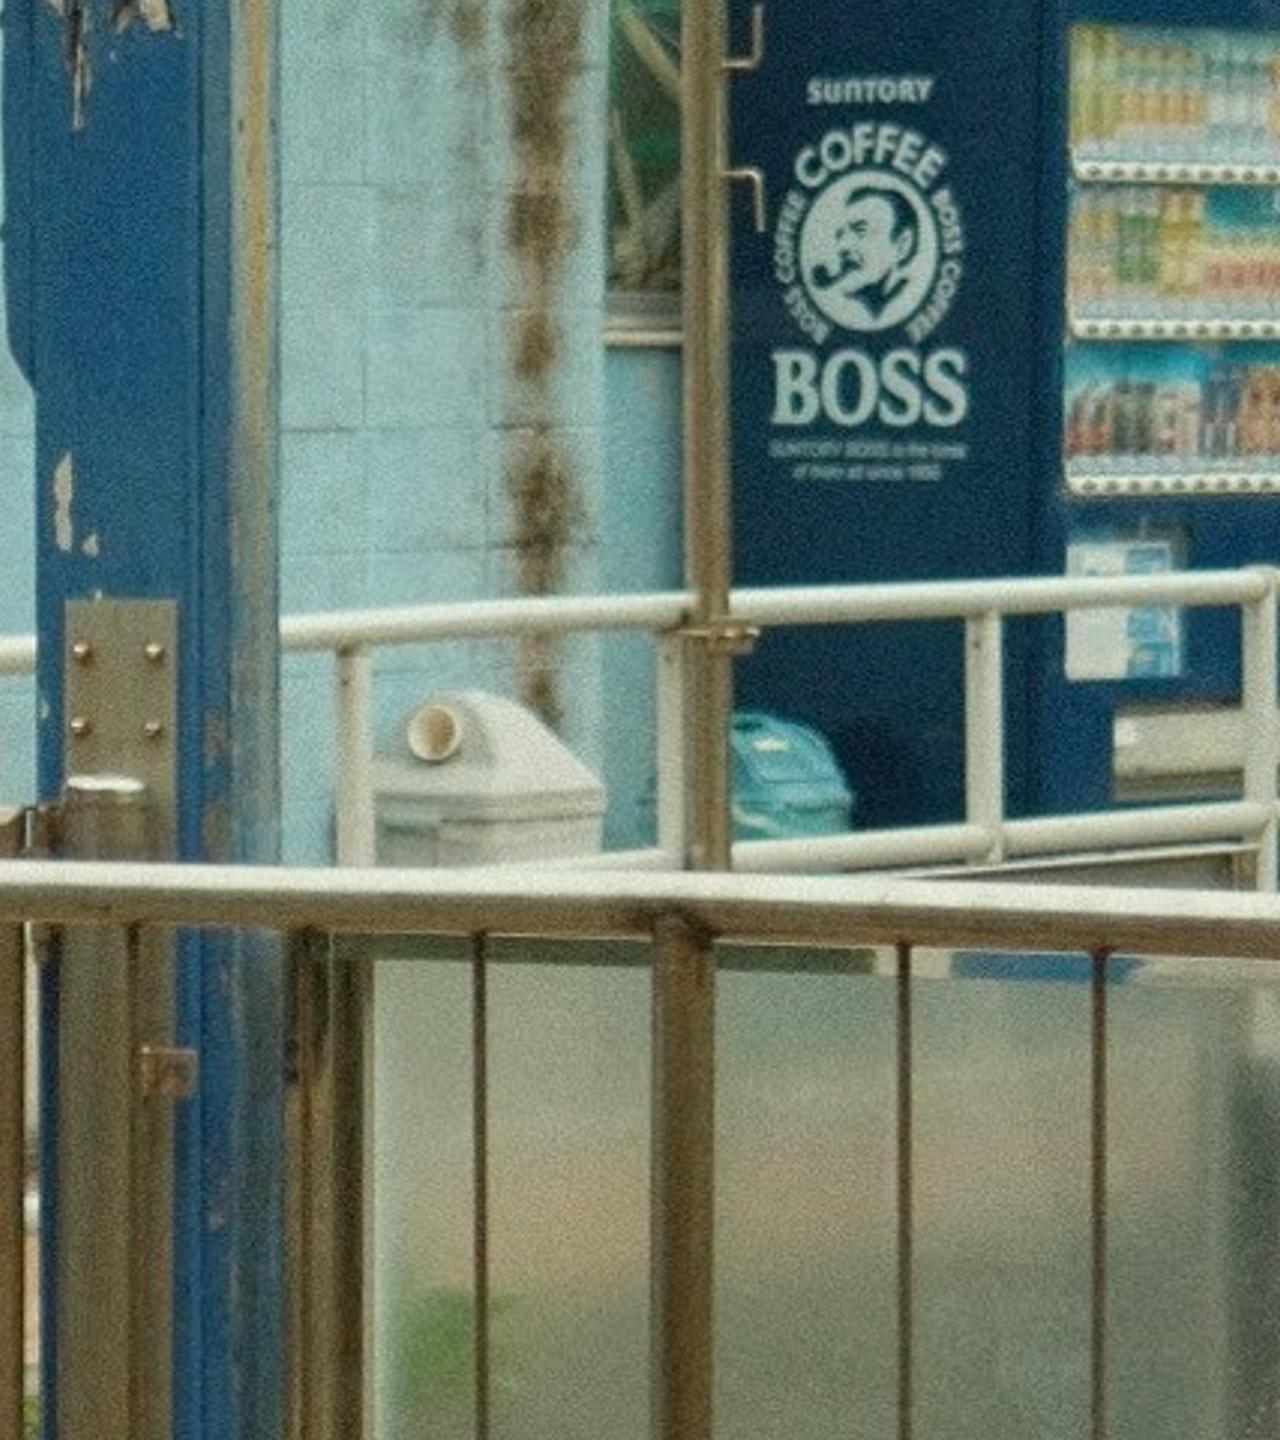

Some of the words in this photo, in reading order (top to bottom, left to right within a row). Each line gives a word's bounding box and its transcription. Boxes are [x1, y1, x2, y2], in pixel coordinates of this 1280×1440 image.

[804, 76, 934, 105] SUNTORY
[794, 120, 946, 190] COFFEE
[769, 349, 969, 427] BOSS
